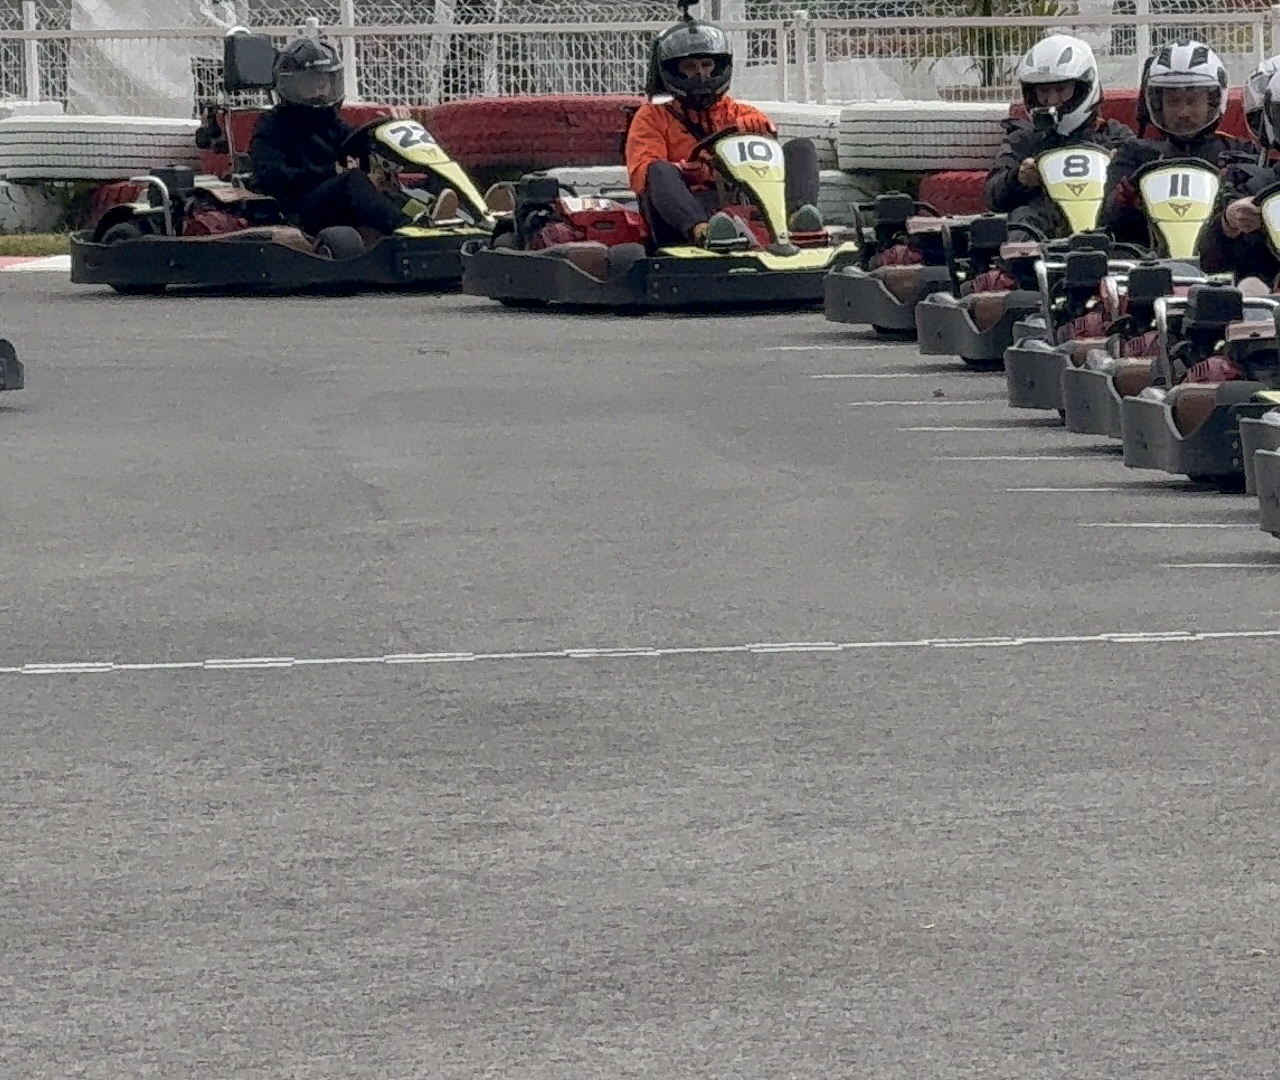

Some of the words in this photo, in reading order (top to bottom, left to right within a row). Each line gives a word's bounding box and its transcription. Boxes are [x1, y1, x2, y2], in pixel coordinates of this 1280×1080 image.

[738, 141, 773, 162] 10
[1063, 155, 1090, 177] 8
[1169, 174, 1190, 197] 11
